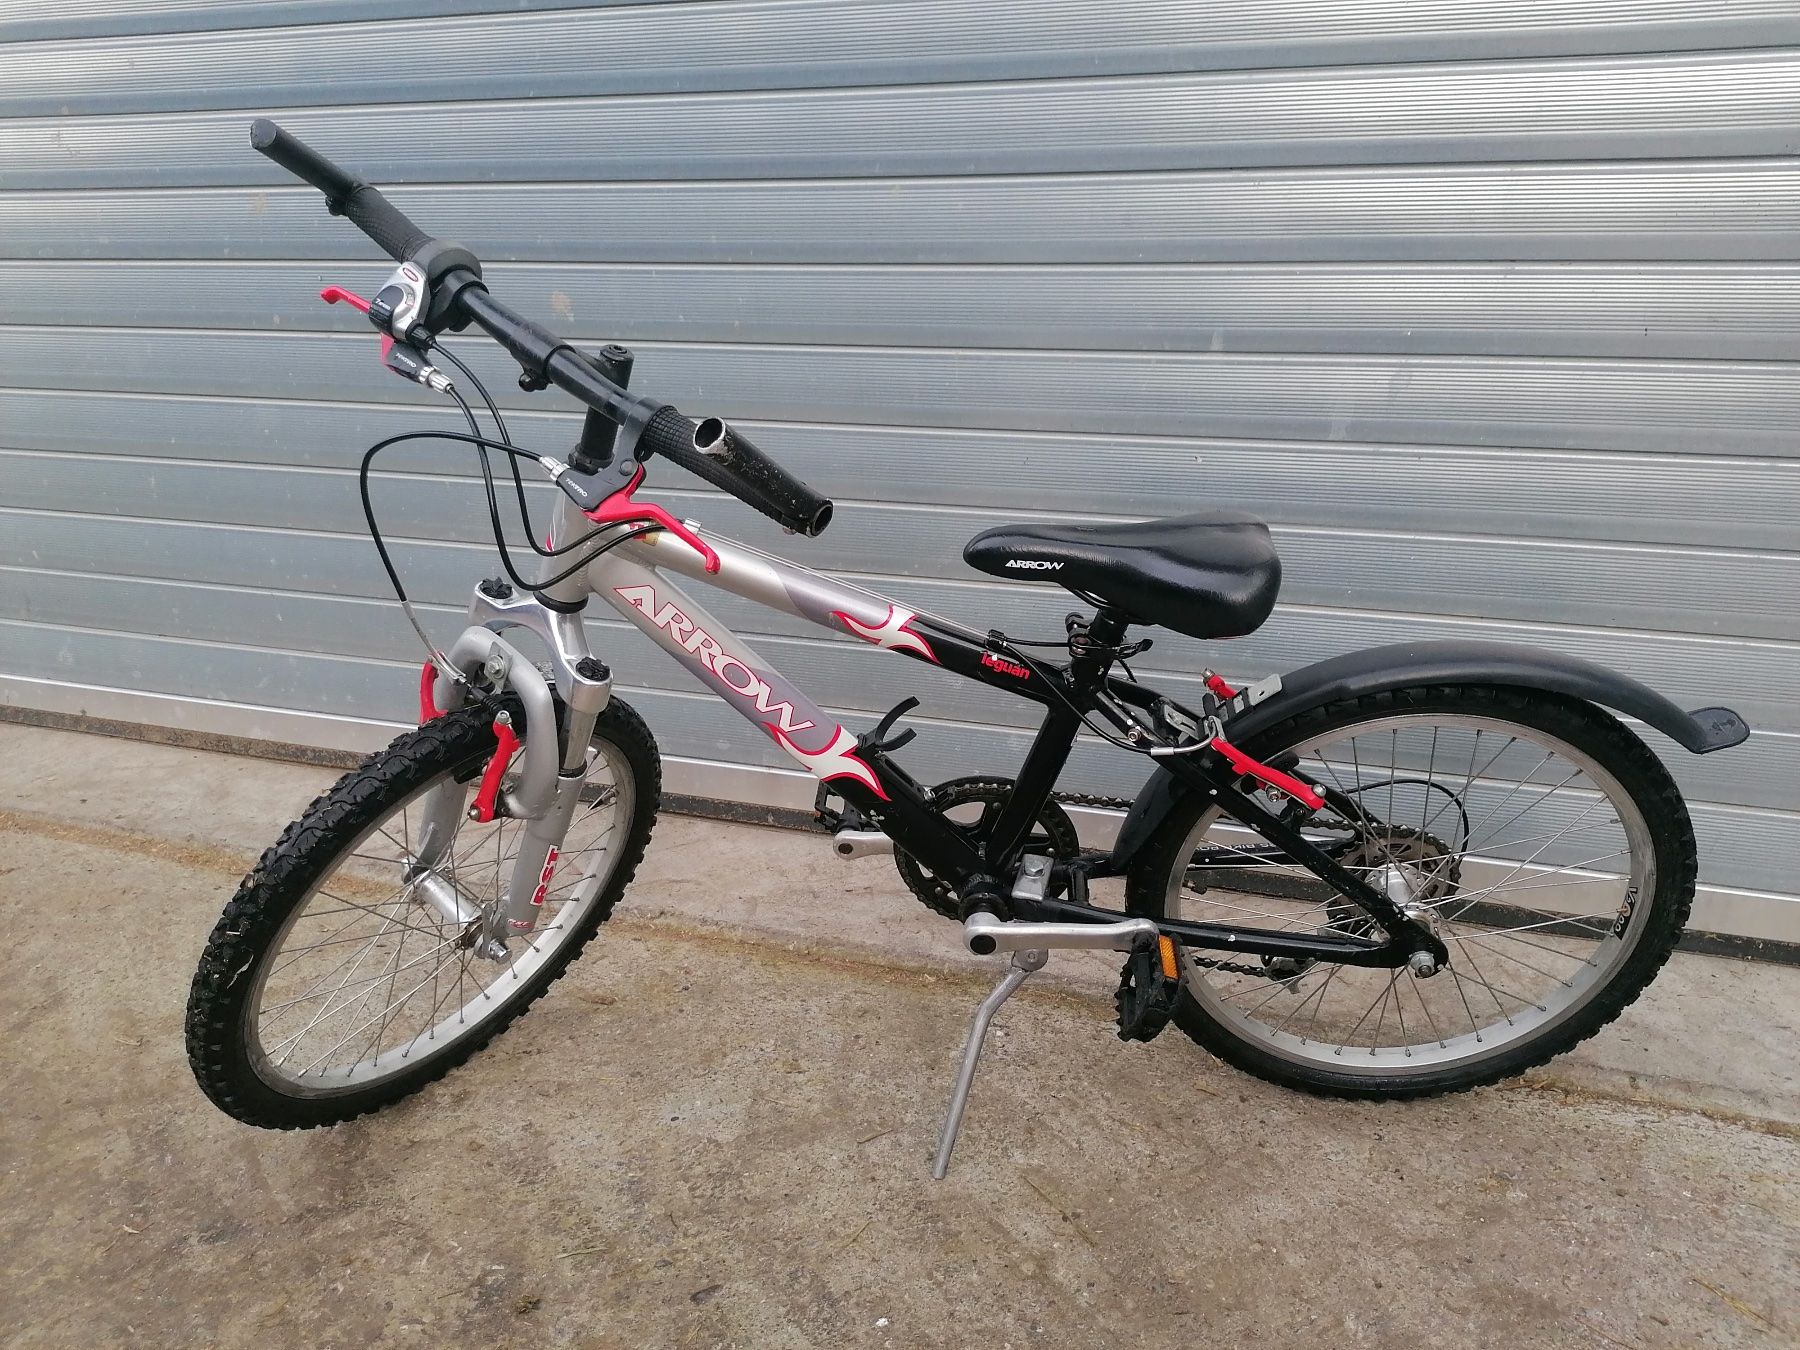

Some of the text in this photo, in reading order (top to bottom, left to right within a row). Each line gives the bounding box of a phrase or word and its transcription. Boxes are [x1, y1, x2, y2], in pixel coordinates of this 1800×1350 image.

[1005, 559, 1065, 570] ARROW
[613, 585, 816, 733] ARROW
[531, 846, 559, 905] RST
